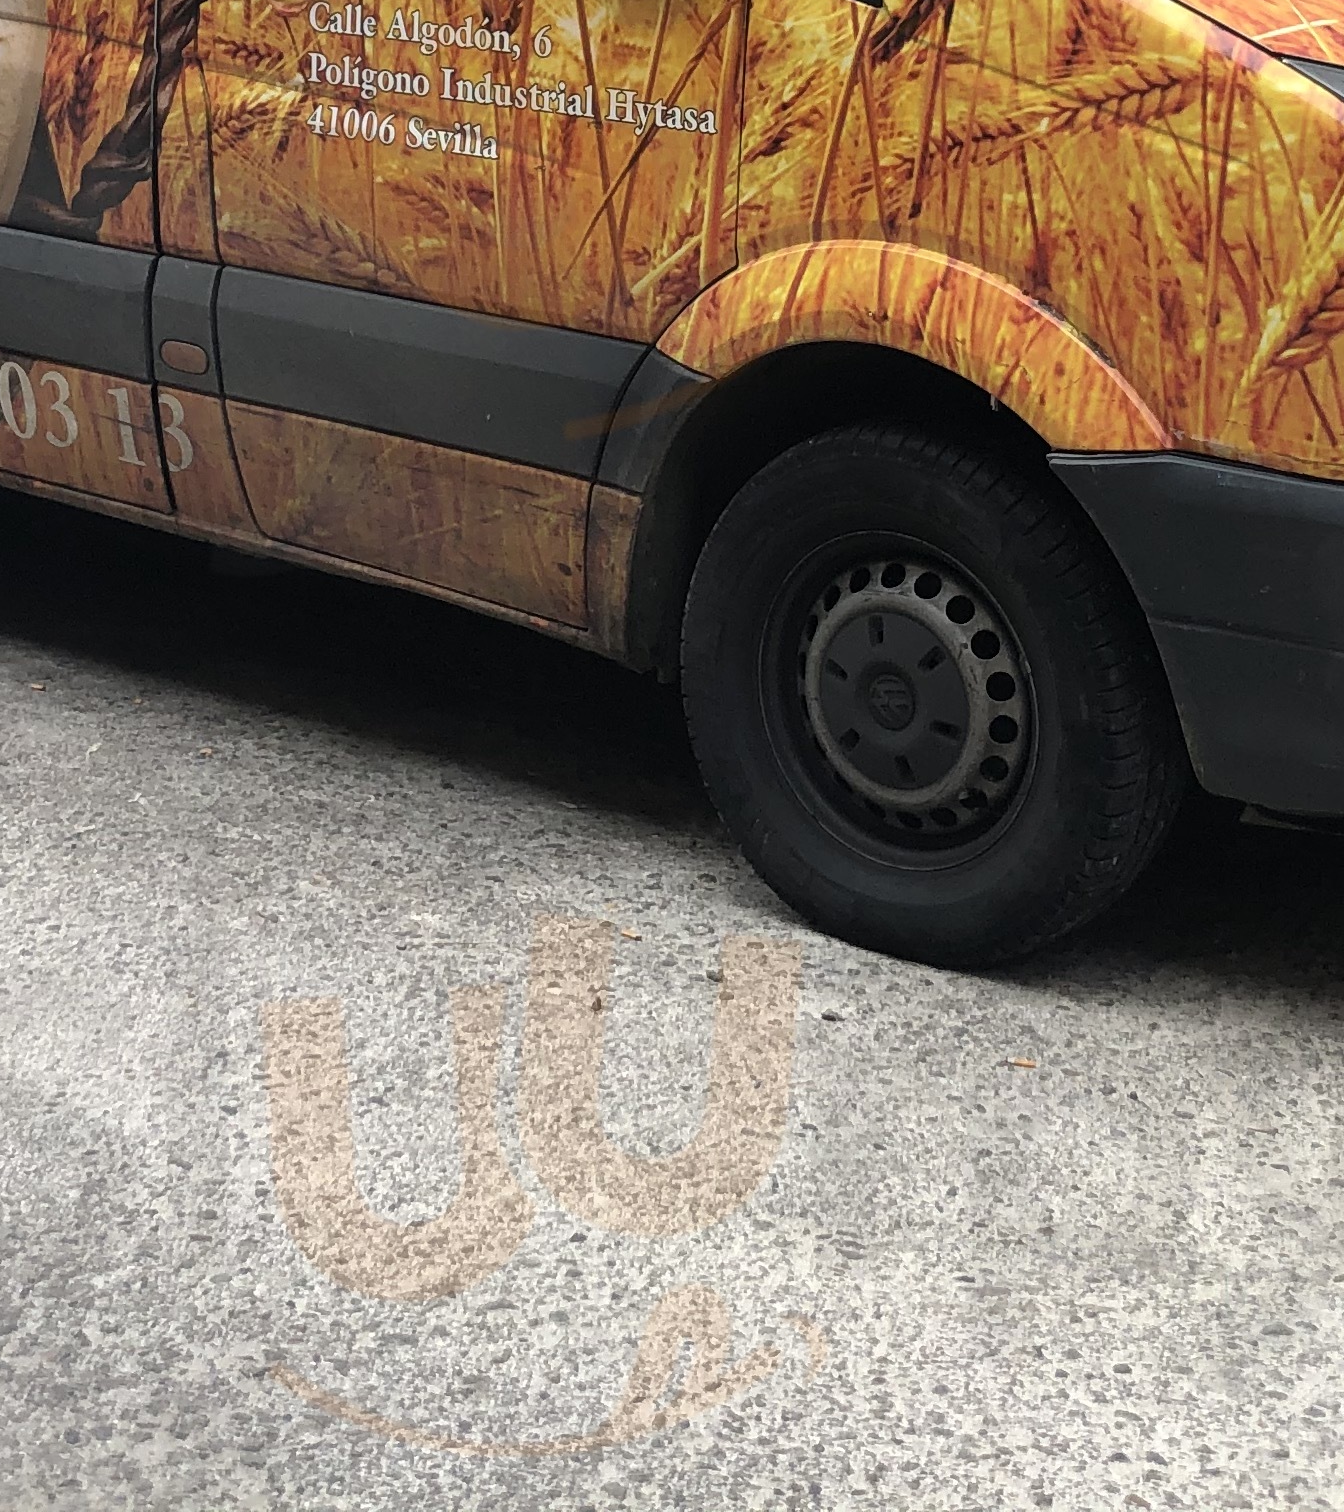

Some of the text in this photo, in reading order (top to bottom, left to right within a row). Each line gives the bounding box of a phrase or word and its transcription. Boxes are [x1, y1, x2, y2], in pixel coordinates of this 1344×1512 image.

[309, 1, 552, 60] Calle Algodón, 6
[308, 52, 718, 136] Polígono Industrial Hytasa
[307, 103, 499, 160] 41006 Sevilla
[106, 386, 195, 473] 13
